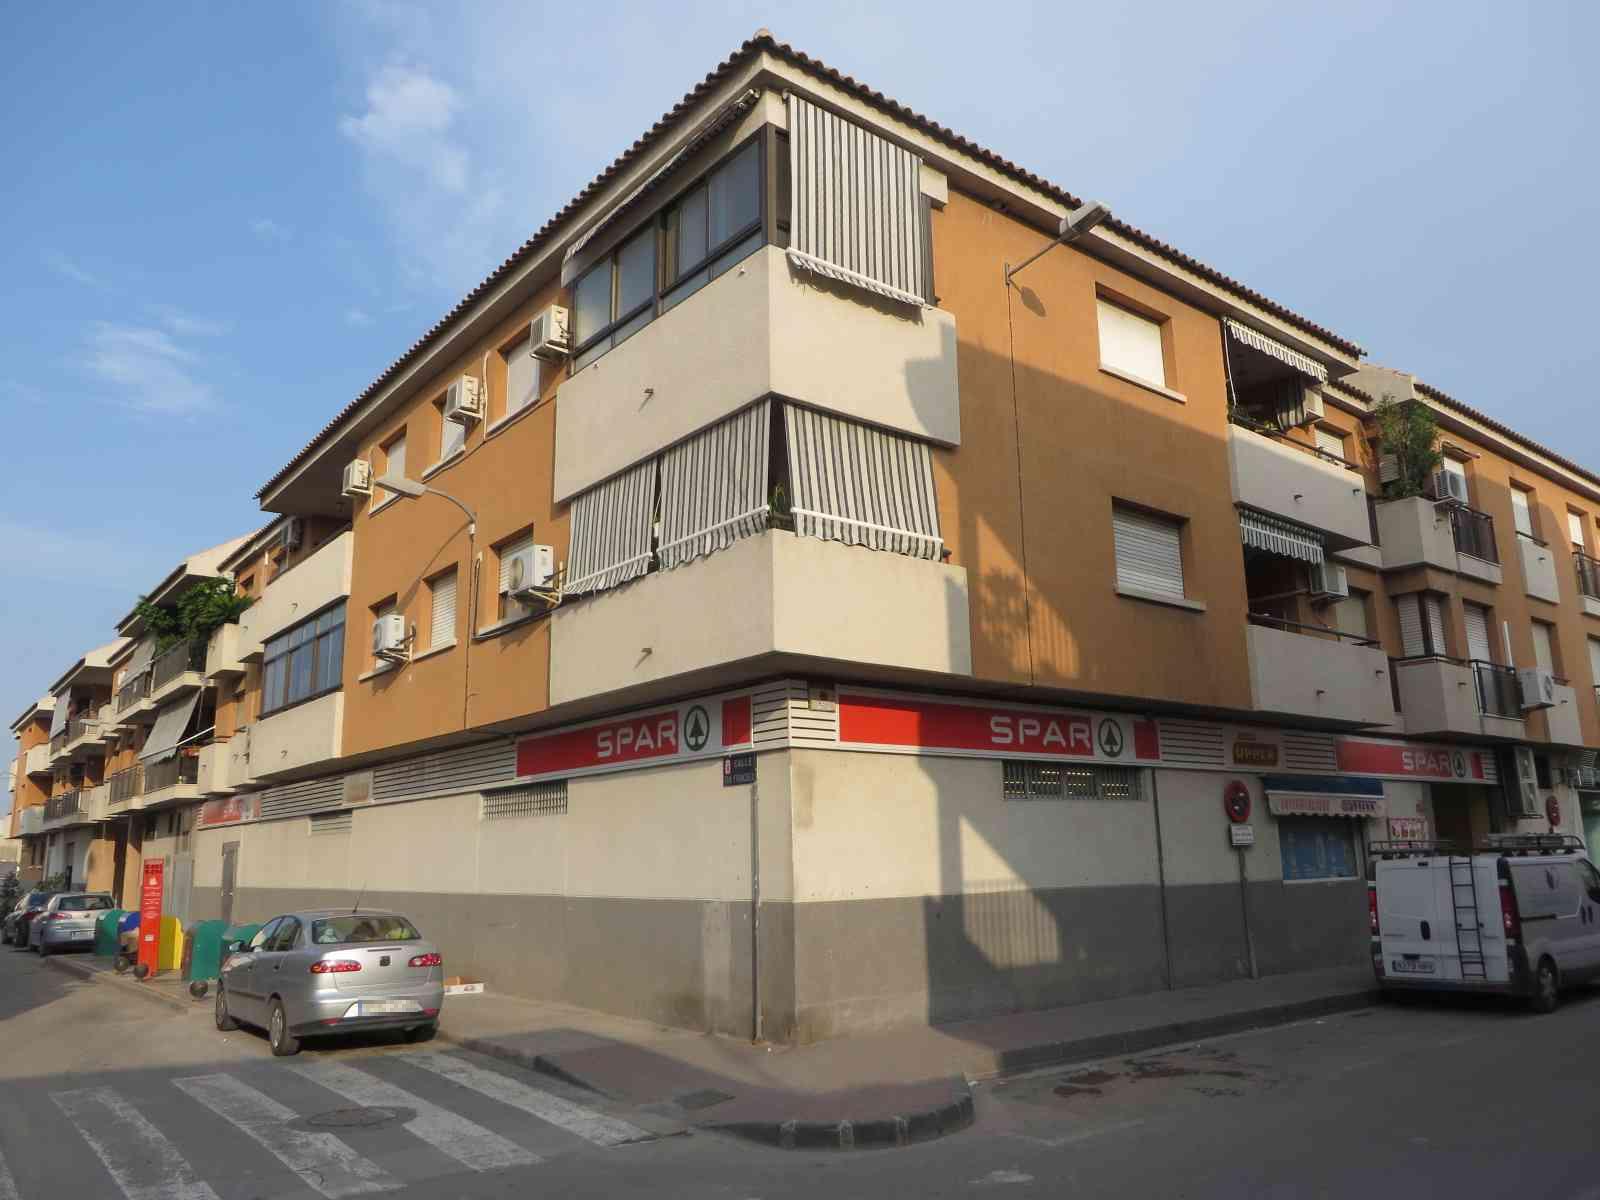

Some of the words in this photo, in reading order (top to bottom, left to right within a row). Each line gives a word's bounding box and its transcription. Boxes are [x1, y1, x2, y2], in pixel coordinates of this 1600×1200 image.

[597, 719, 677, 758] SPAR
[990, 716, 1091, 748] SPAR
[1402, 751, 1450, 773] SPAR
